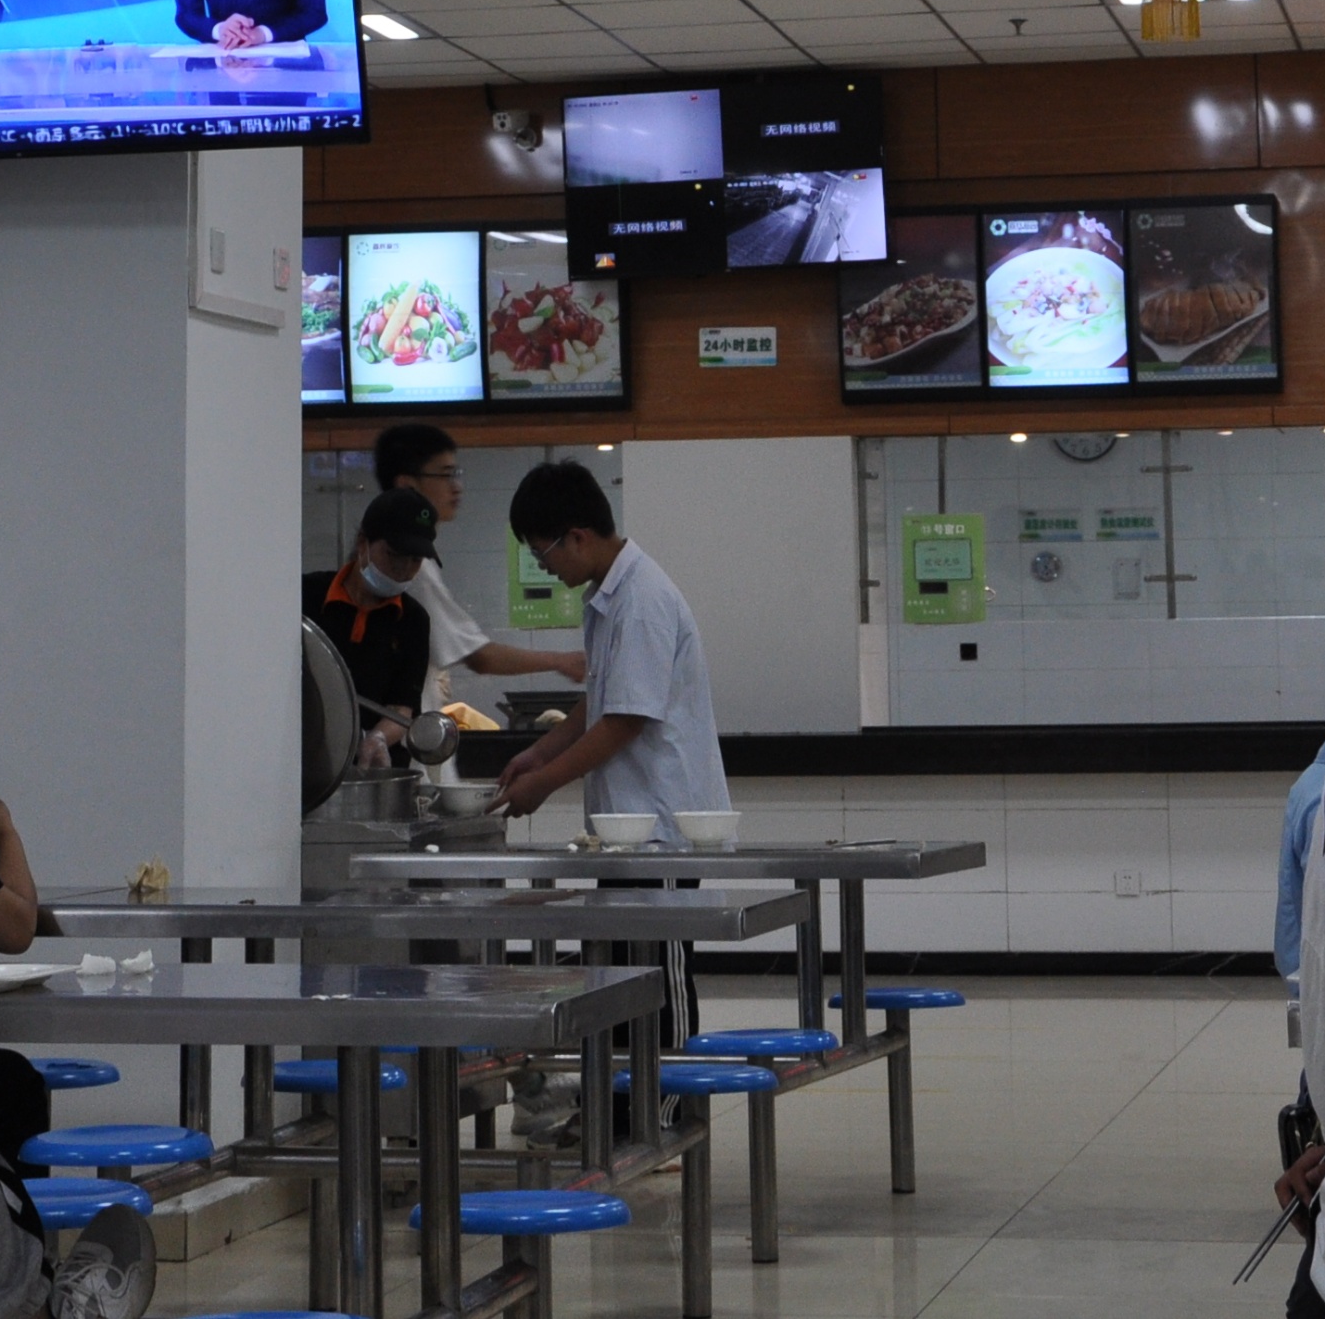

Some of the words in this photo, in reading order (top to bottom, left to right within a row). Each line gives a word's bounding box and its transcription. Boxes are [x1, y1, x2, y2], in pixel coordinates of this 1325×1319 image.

[765, 121, 838, 137] 无网络视频
[612, 219, 684, 235] 无网络视频
[704, 337, 772, 352] 24小时监控
